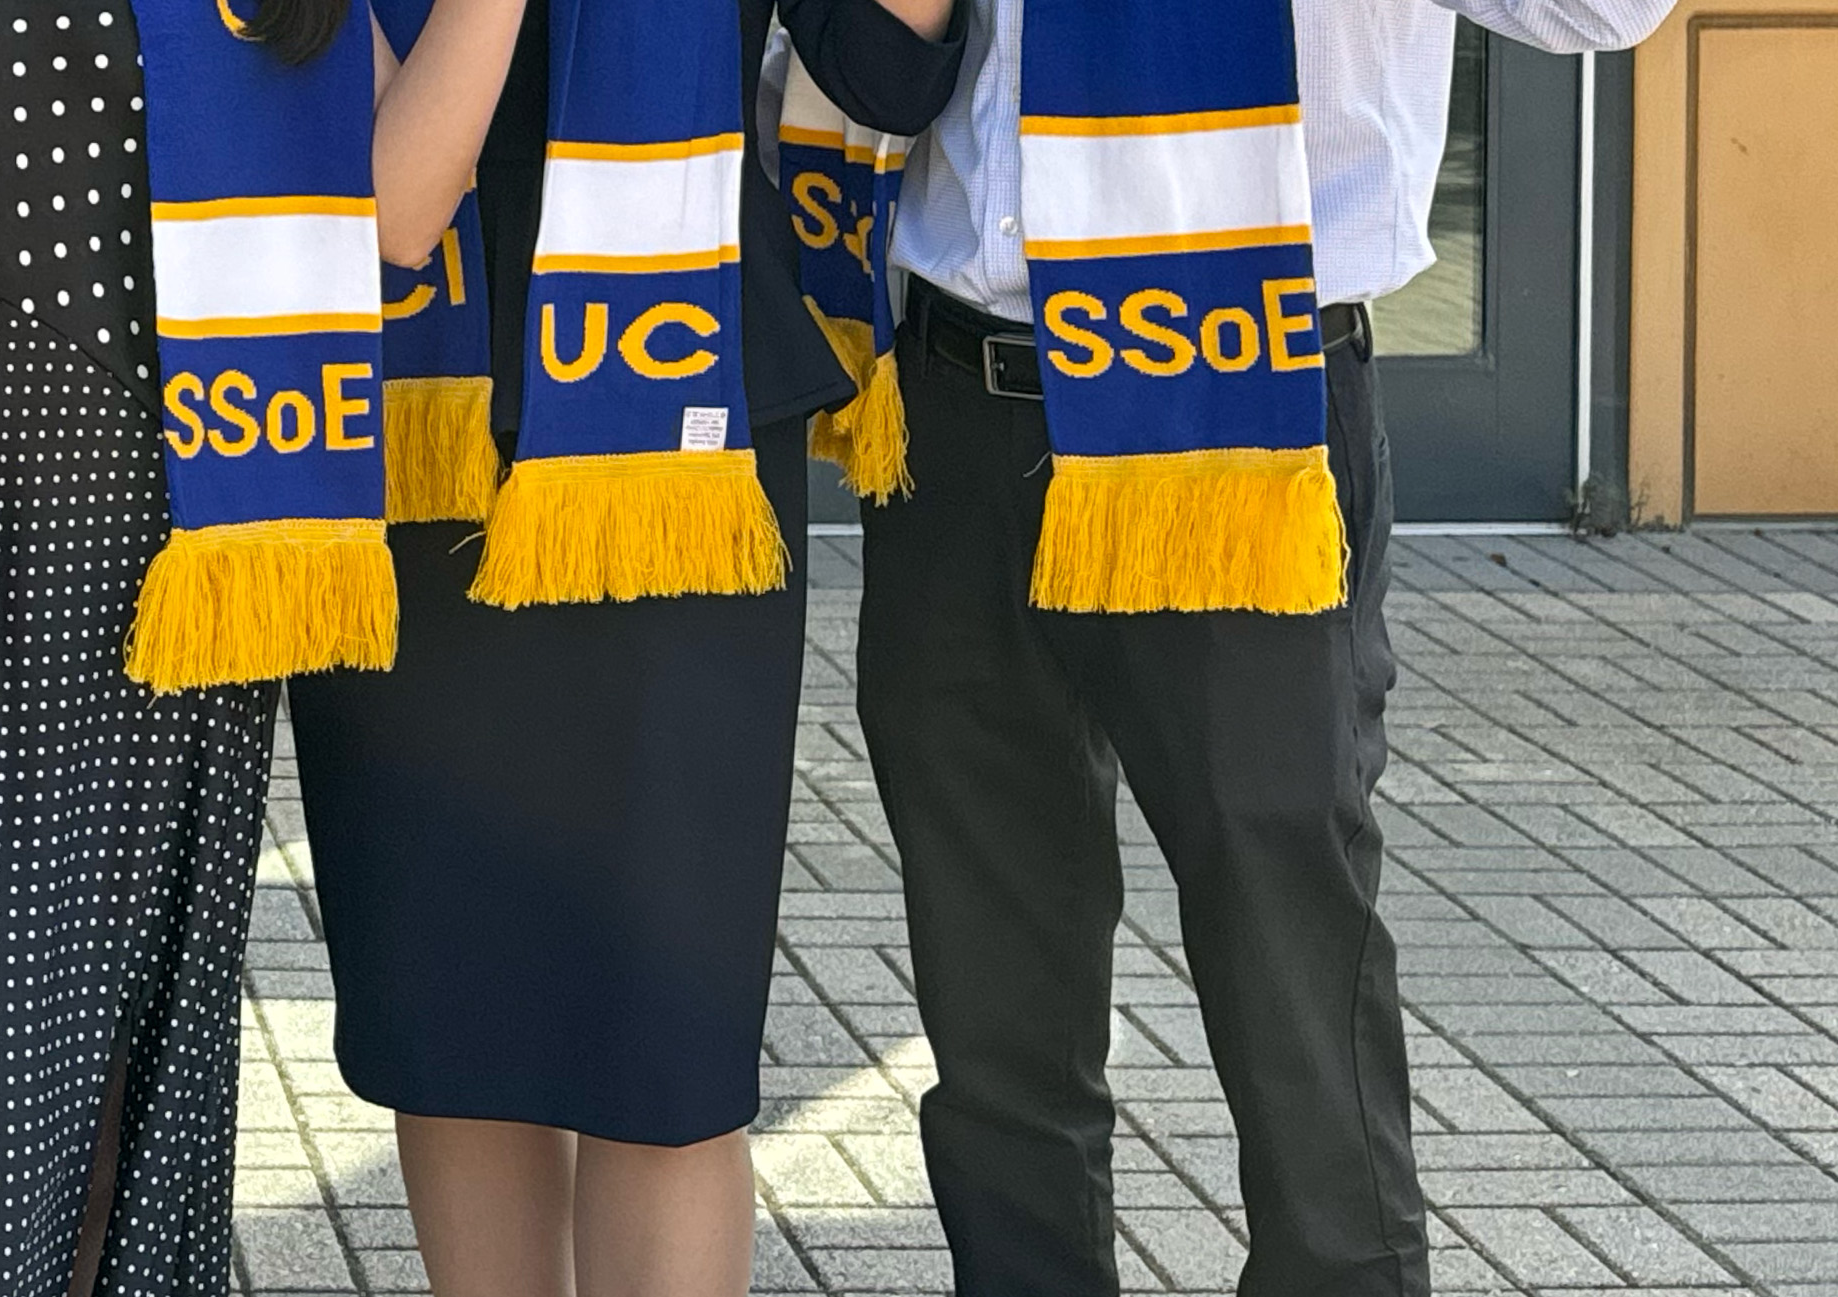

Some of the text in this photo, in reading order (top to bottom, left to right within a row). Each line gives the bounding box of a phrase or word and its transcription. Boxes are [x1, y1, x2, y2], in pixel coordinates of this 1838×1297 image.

[540, 301, 721, 383] UC
[1043, 276, 1326, 380] SSoE
[165, 362, 376, 460] SSoE
